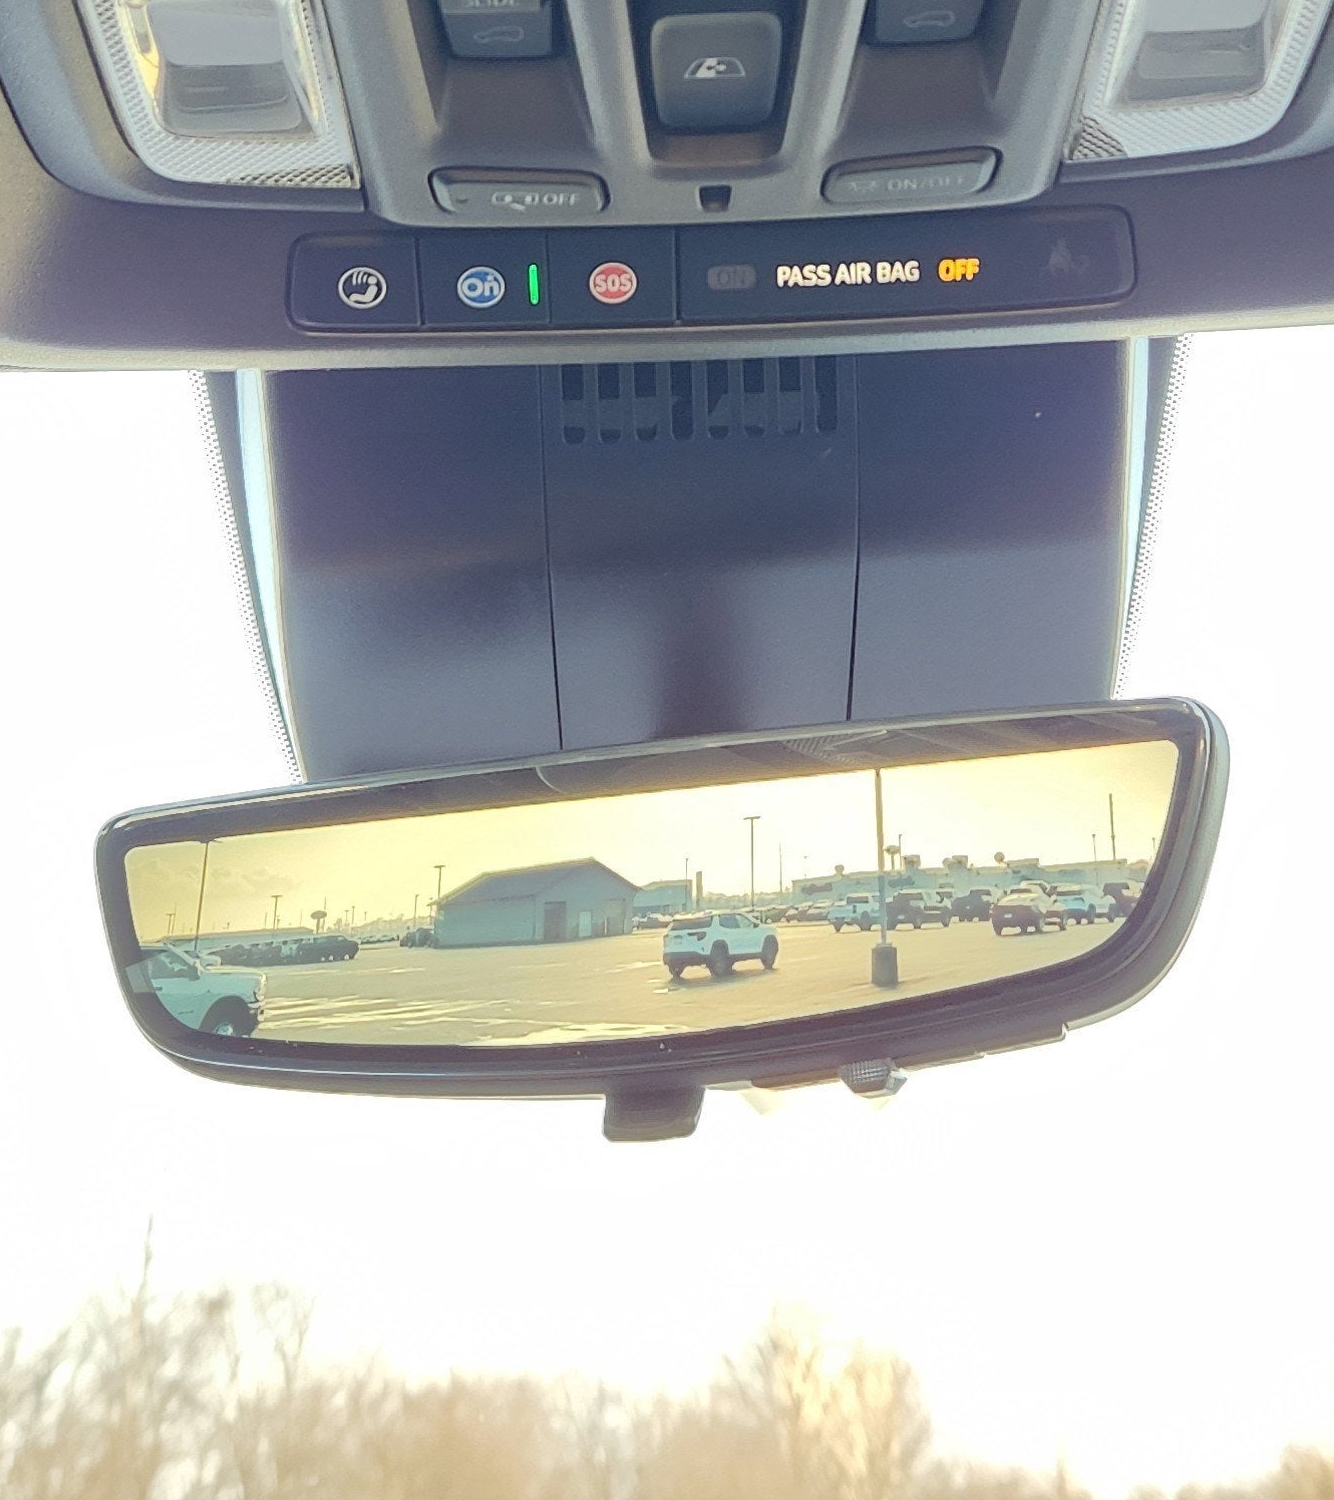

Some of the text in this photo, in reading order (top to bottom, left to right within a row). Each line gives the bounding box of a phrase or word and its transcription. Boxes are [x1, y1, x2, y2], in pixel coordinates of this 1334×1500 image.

[887, 176, 965, 192] ON/OFF
[543, 193, 578, 206] OFF
[717, 268, 747, 286] ON
[776, 257, 981, 288] PASS AIR BAG OFF
[595, 274, 632, 293] SOS
